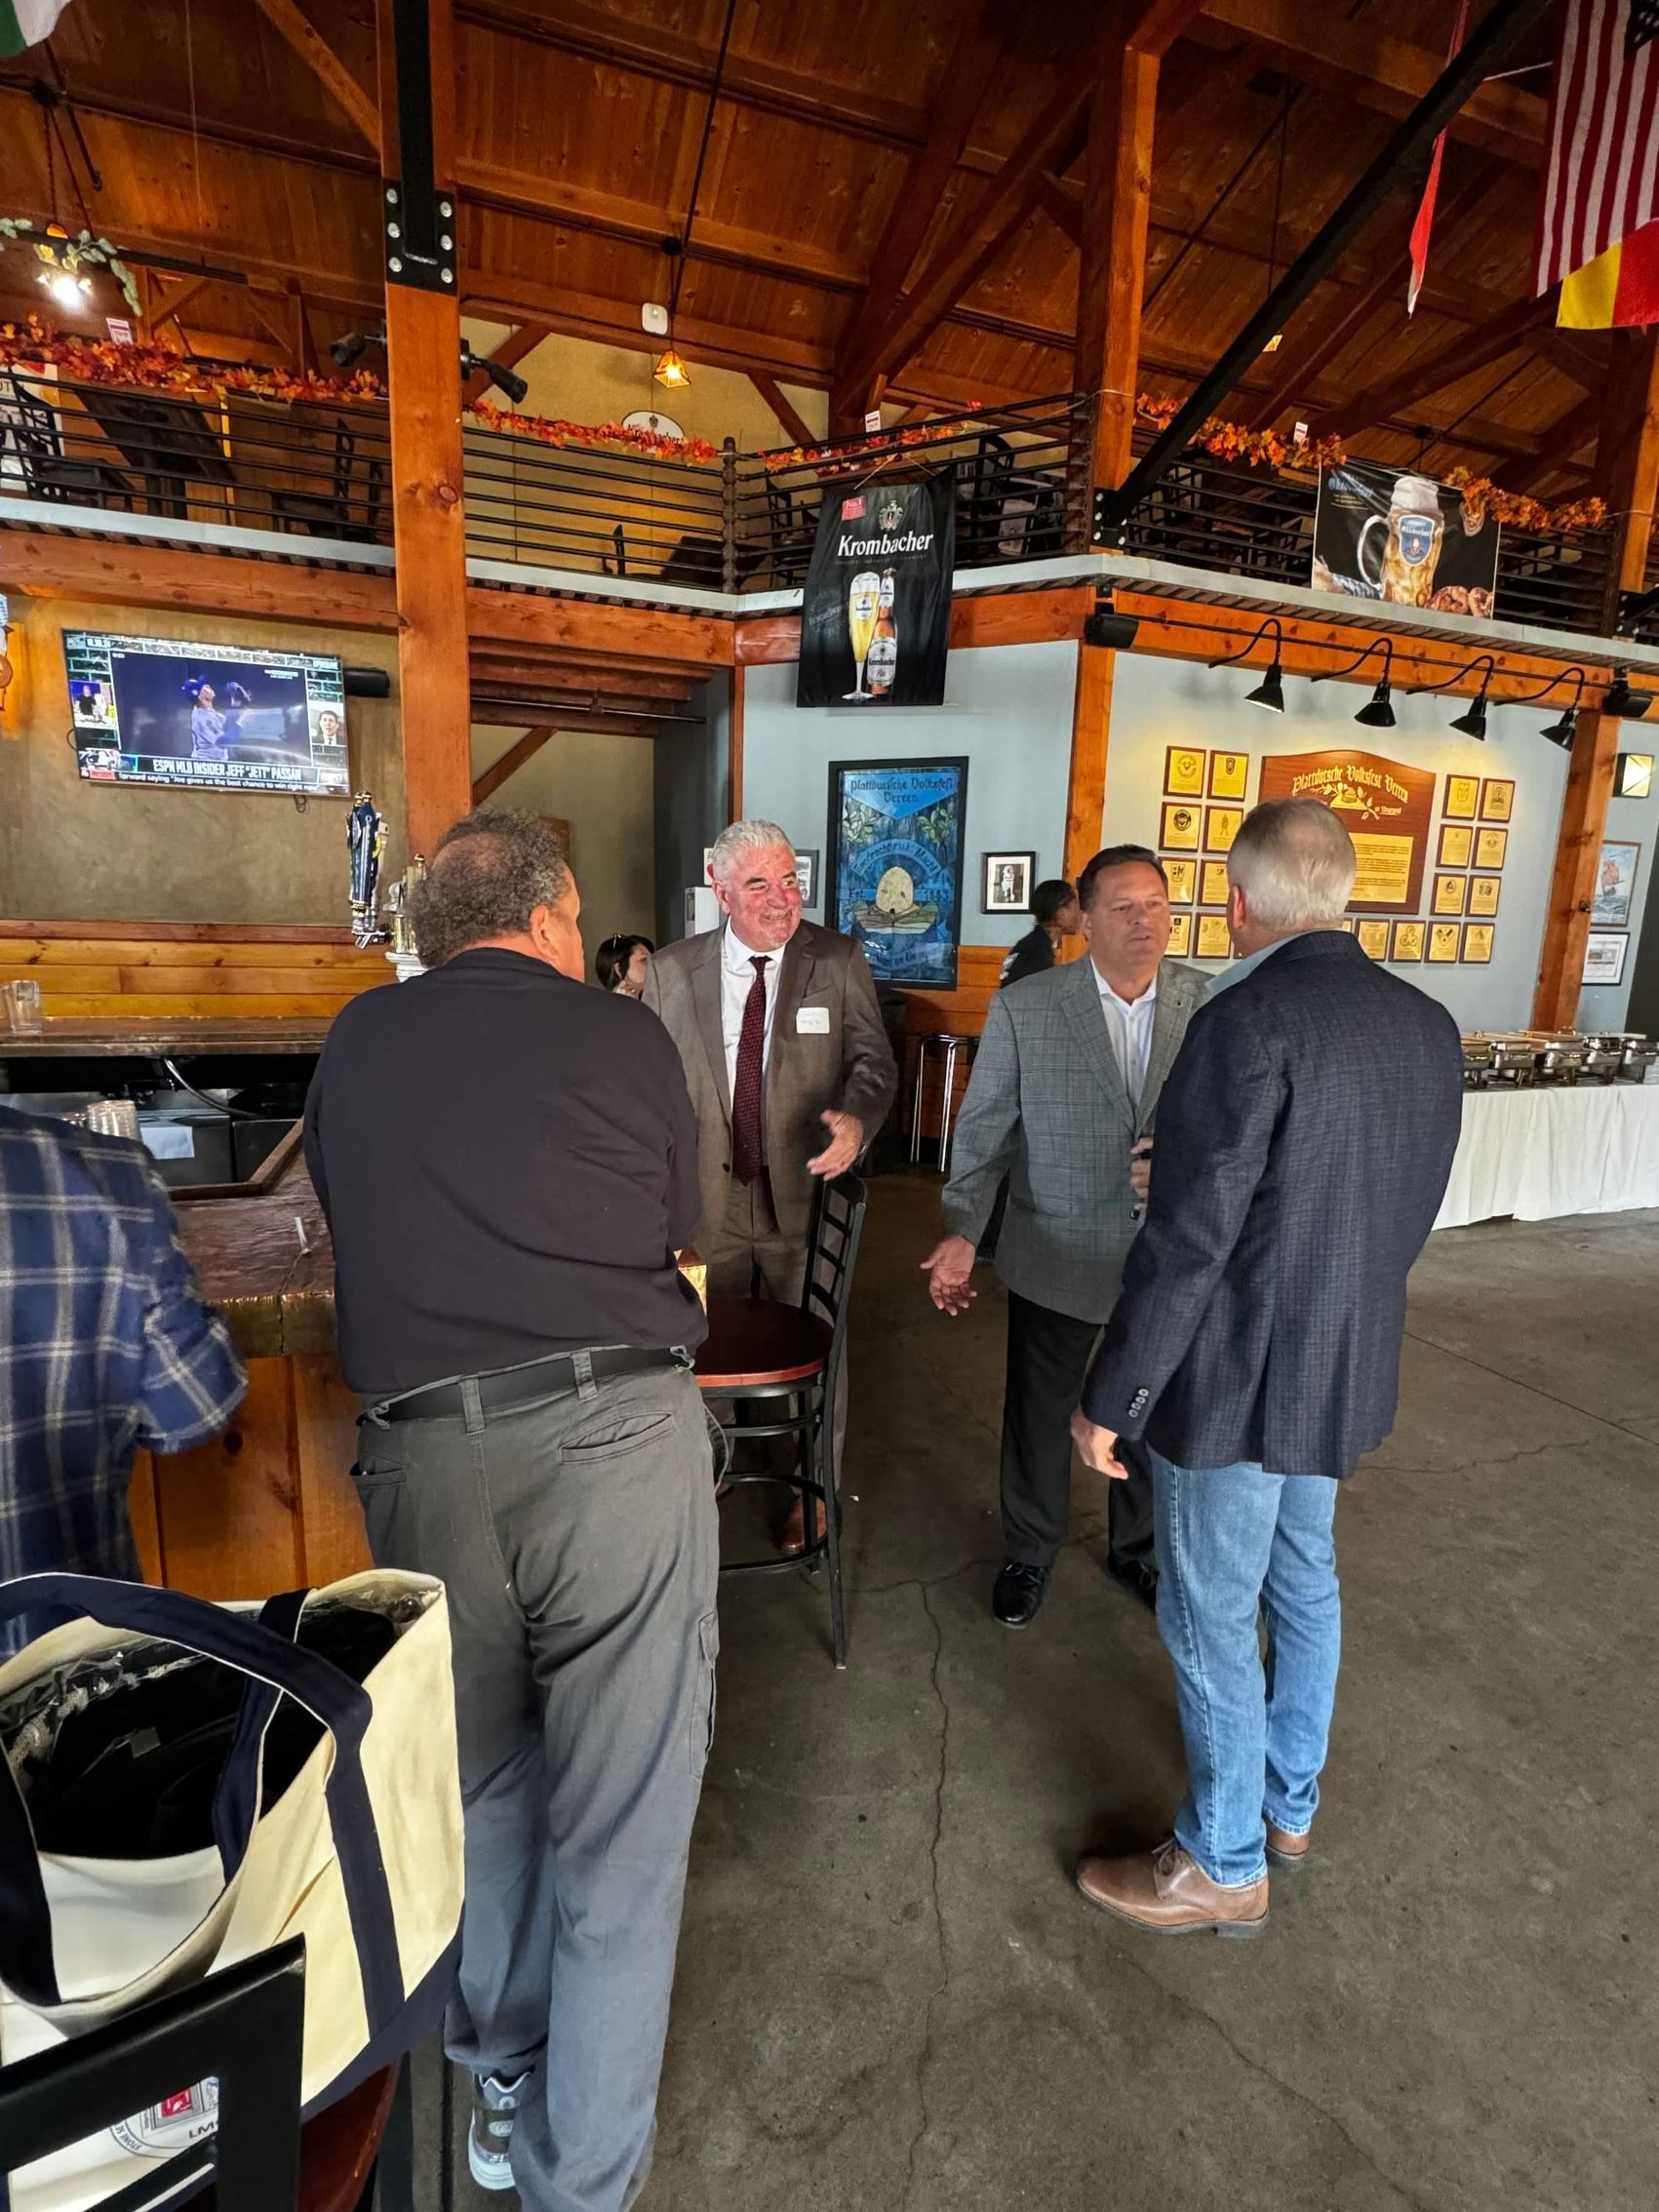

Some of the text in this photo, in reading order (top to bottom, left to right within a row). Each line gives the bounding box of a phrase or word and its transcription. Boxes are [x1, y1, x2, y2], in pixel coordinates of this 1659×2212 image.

[837, 530, 934, 557] Krombacher
[152, 759, 176, 773] ESPN
[176, 761, 193, 774] MLB
[193, 761, 225, 776] INSIDER
[225, 764, 246, 777] JEFF
[271, 767, 302, 781] PASSAN
[188, 2118, 218, 2139] LM
[118, 2132, 143, 2151] STONE
